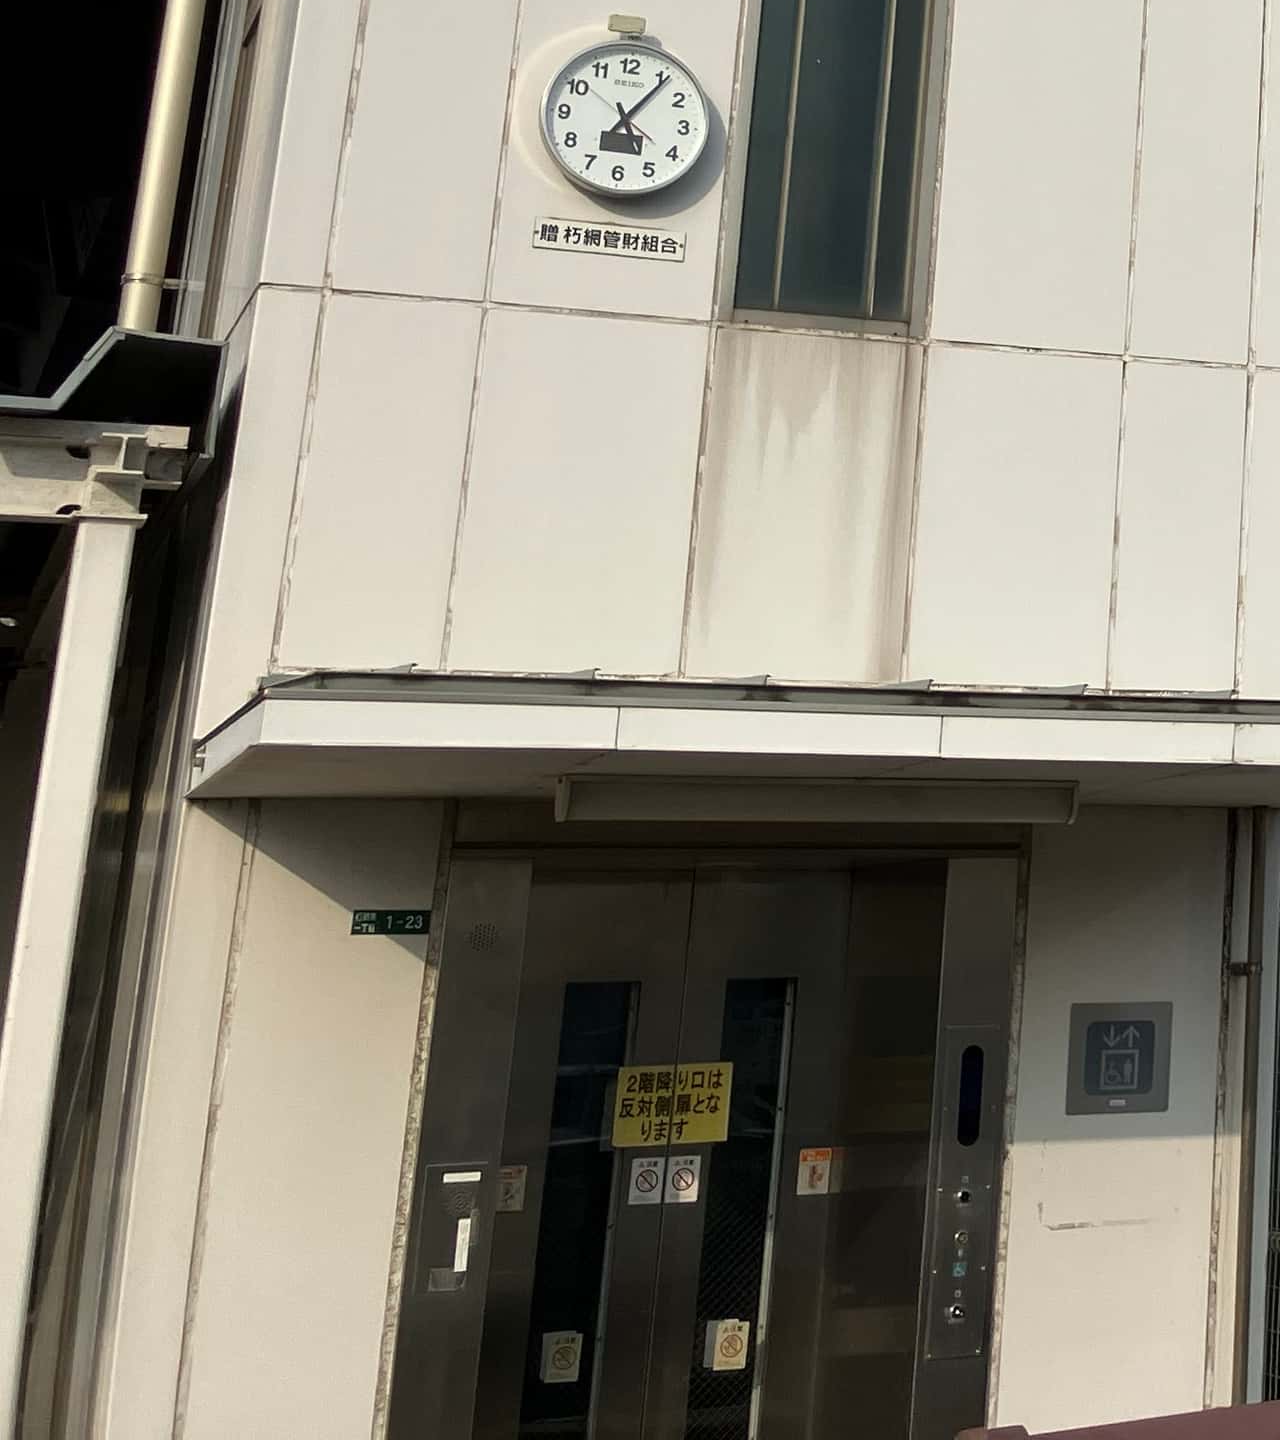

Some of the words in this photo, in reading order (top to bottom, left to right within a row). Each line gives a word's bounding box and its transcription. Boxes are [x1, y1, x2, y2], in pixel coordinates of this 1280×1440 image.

[592, 62, 609, 79] 11
[620, 58, 641, 75] 12
[567, 78, 589, 96] 10
[672, 93, 686, 108] 2
[558, 104, 571, 119] 9
[677, 120, 690, 136] 3
[564, 132, 577, 148] 8
[665, 145, 679, 162] 4
[584, 154, 597, 171] 7
[642, 162, 656, 178] 5
[612, 165, 625, 182] 6
[540, 223, 558, 243] 贈
[563, 225, 679, 255] 朽網管財組合
[386, 914, 423, 929] 1-23
[626, 1069, 723, 1093] 2階降り口は
[619, 1094, 720, 1118] 反対側扉とな
[641, 1119, 689, 1141] ります
